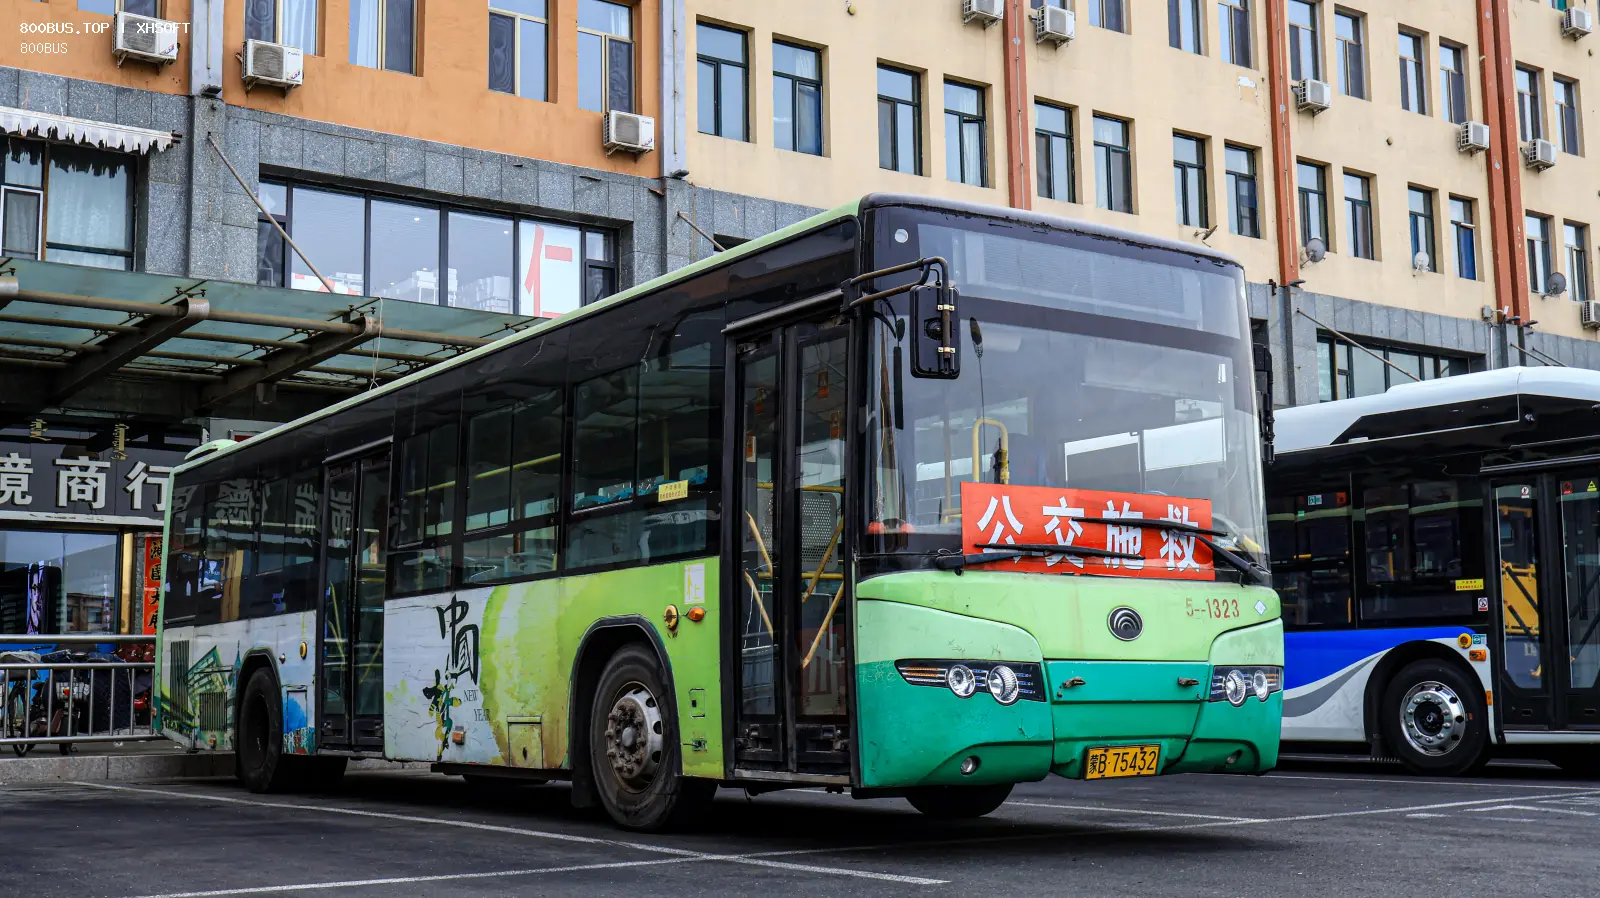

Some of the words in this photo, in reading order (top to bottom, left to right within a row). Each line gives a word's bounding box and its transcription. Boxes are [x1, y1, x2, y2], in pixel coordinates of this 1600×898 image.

[976, 495, 1200, 572] 公交施救
[463, 689, 479, 702] NEW
[473, 708, 491, 722] YEAR
